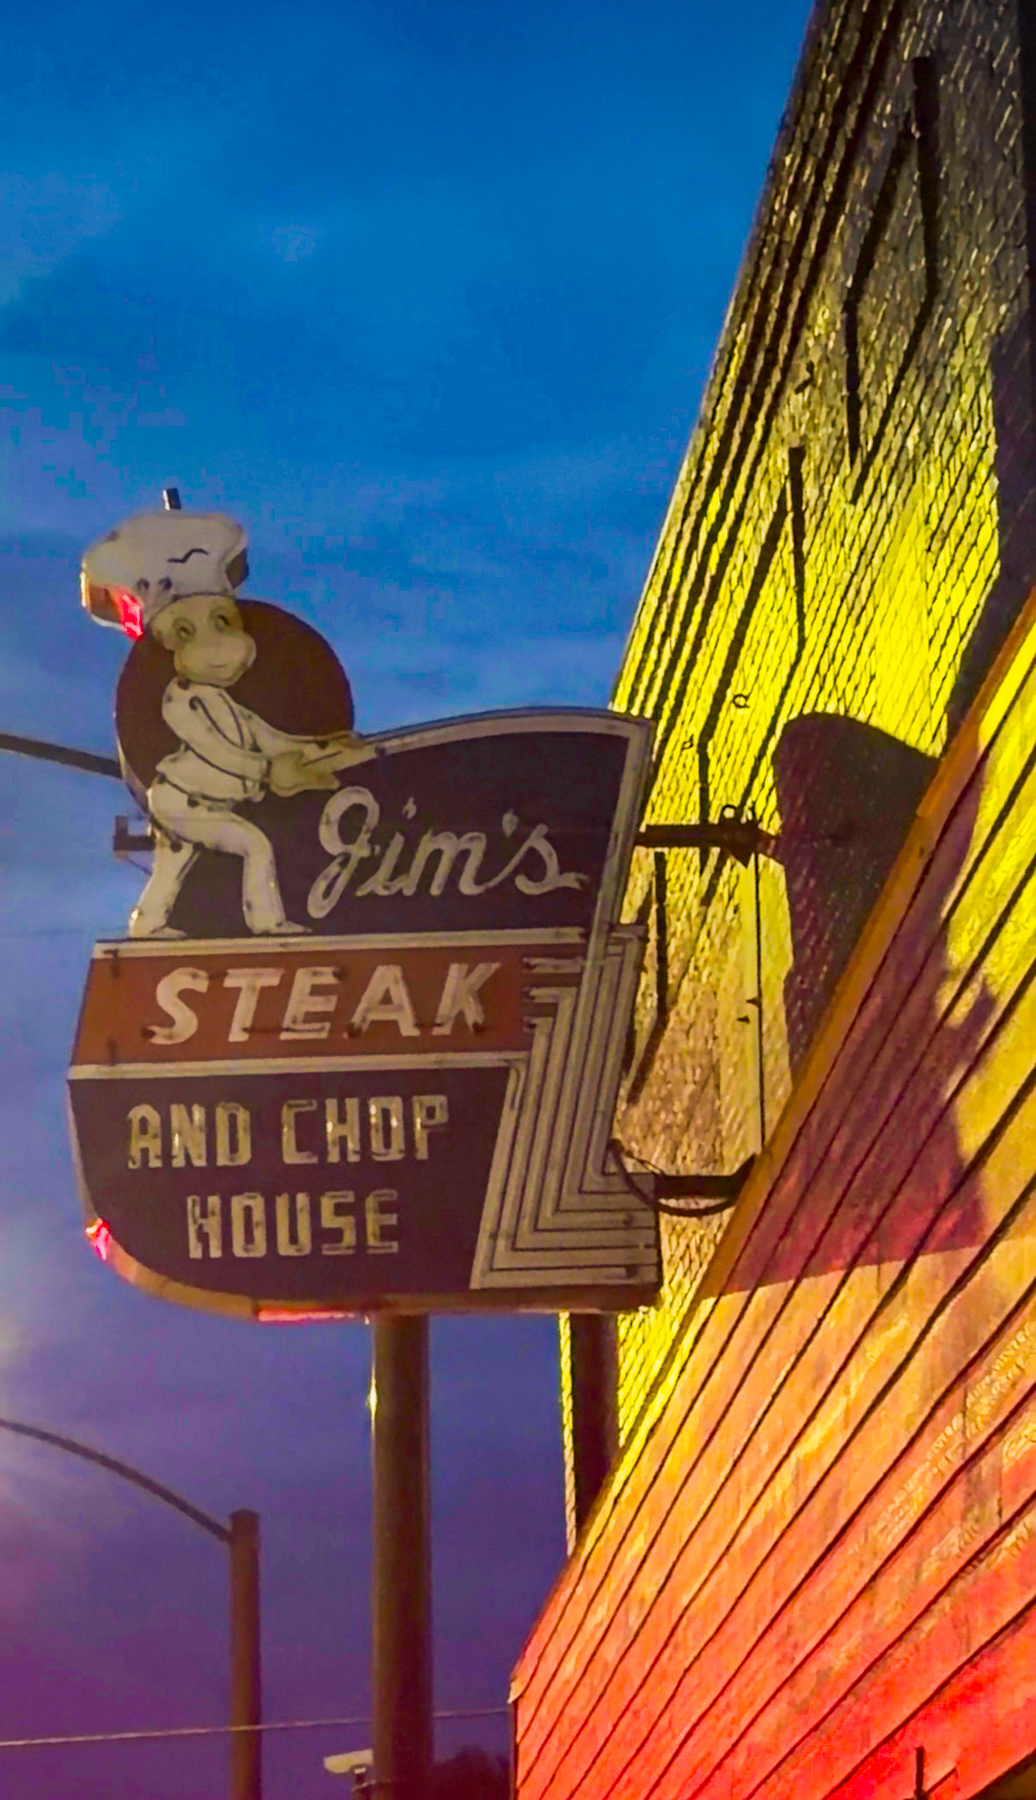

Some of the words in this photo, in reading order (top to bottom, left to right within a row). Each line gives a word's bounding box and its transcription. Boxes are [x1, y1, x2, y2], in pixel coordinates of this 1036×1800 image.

[307, 786, 588, 919] Jim's
[146, 962, 501, 1045] STEAK
[127, 1101, 252, 1169] AND
[281, 1095, 448, 1164] CHOP
[187, 1189, 399, 1259] HOUSE
